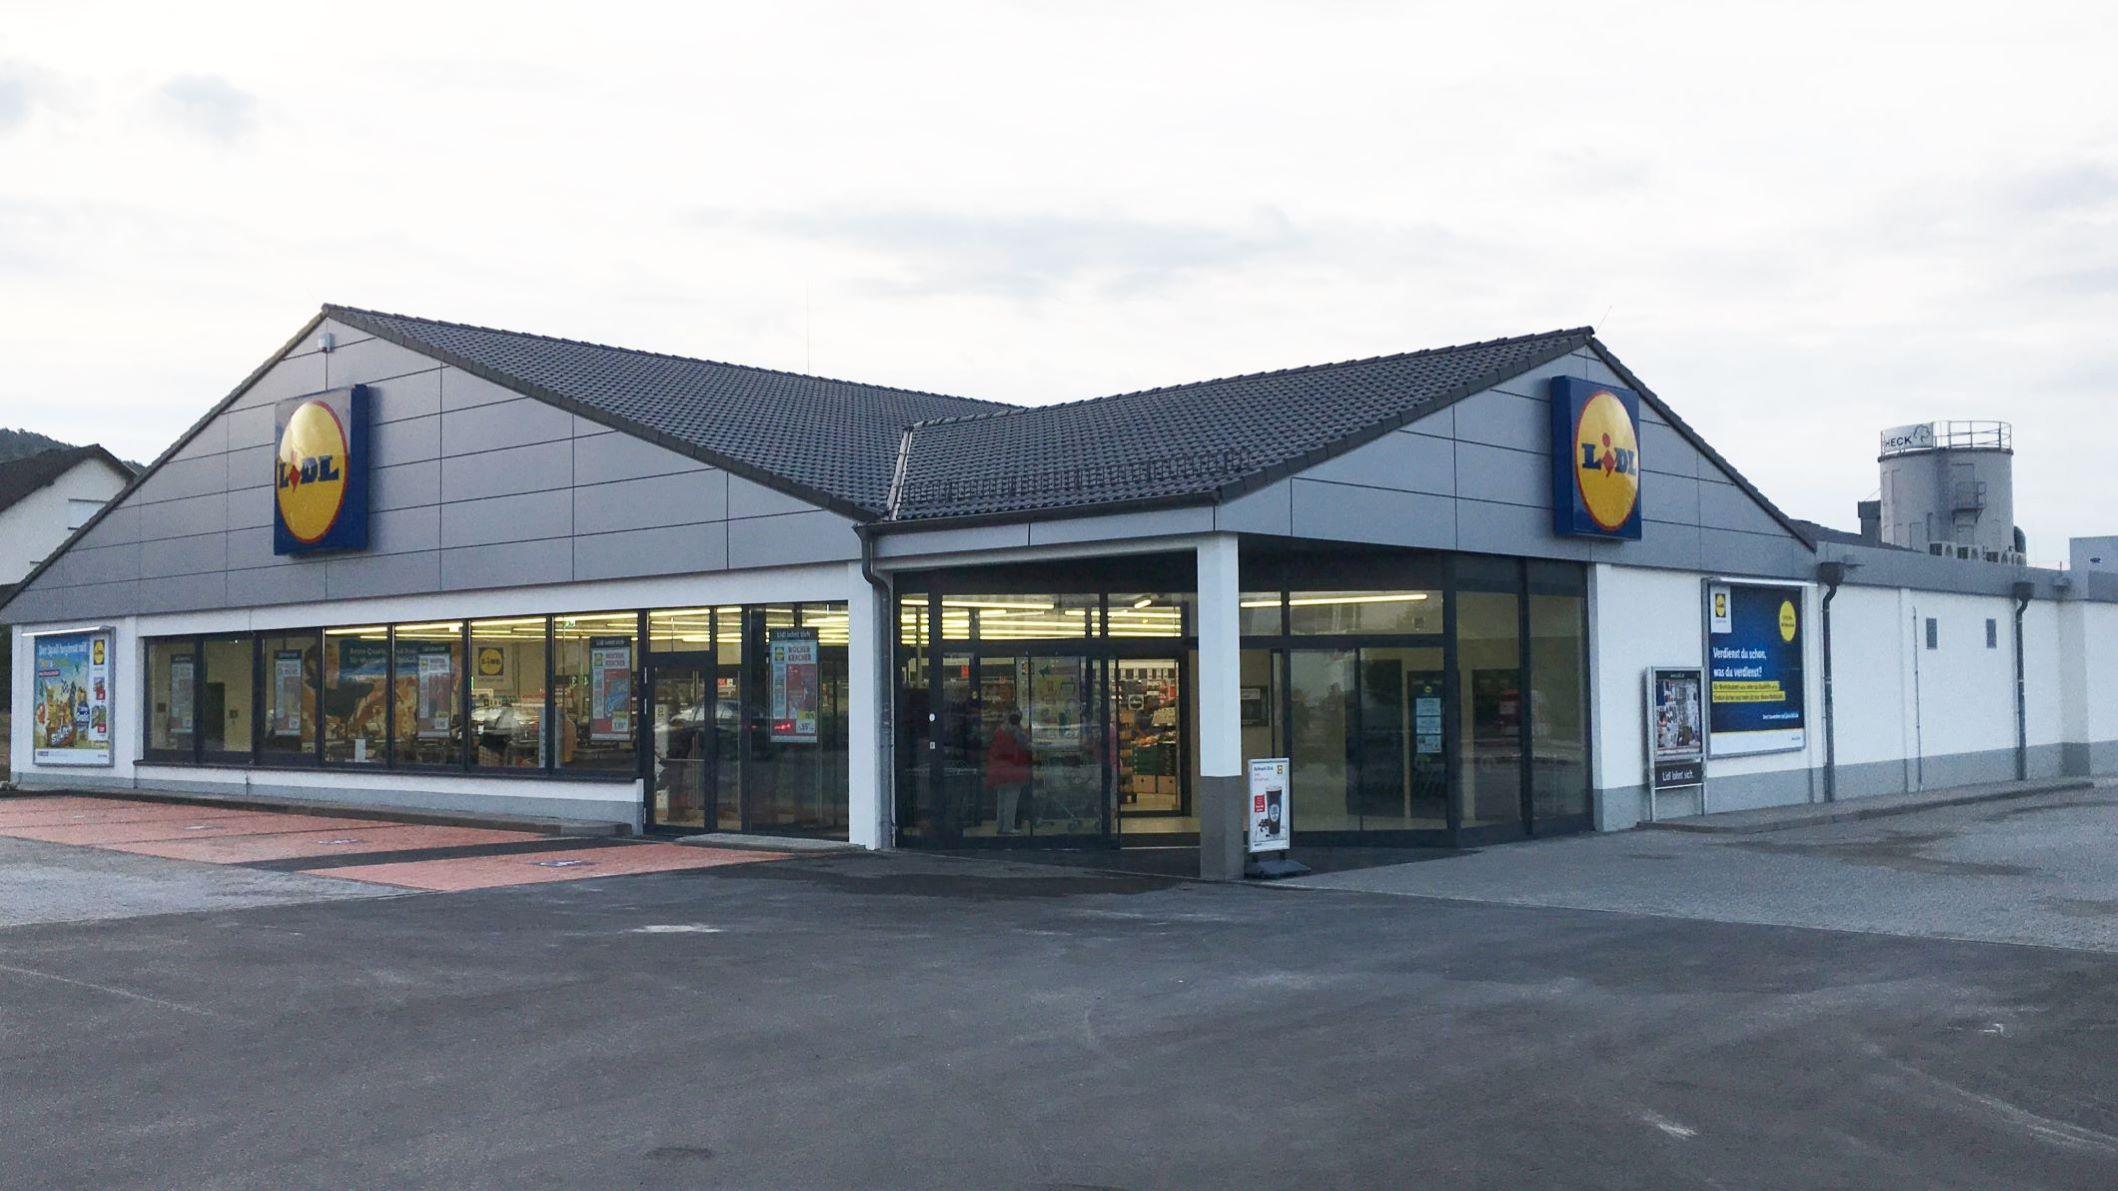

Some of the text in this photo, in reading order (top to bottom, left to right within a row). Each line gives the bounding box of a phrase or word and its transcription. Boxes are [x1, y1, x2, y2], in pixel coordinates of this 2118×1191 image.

[1884, 435, 1912, 448] HECK
[1713, 647, 1740, 659] Verdienst
[1741, 648, 1748, 659] du
[1713, 668, 1724, 677] was
[1725, 666, 1733, 677] du
